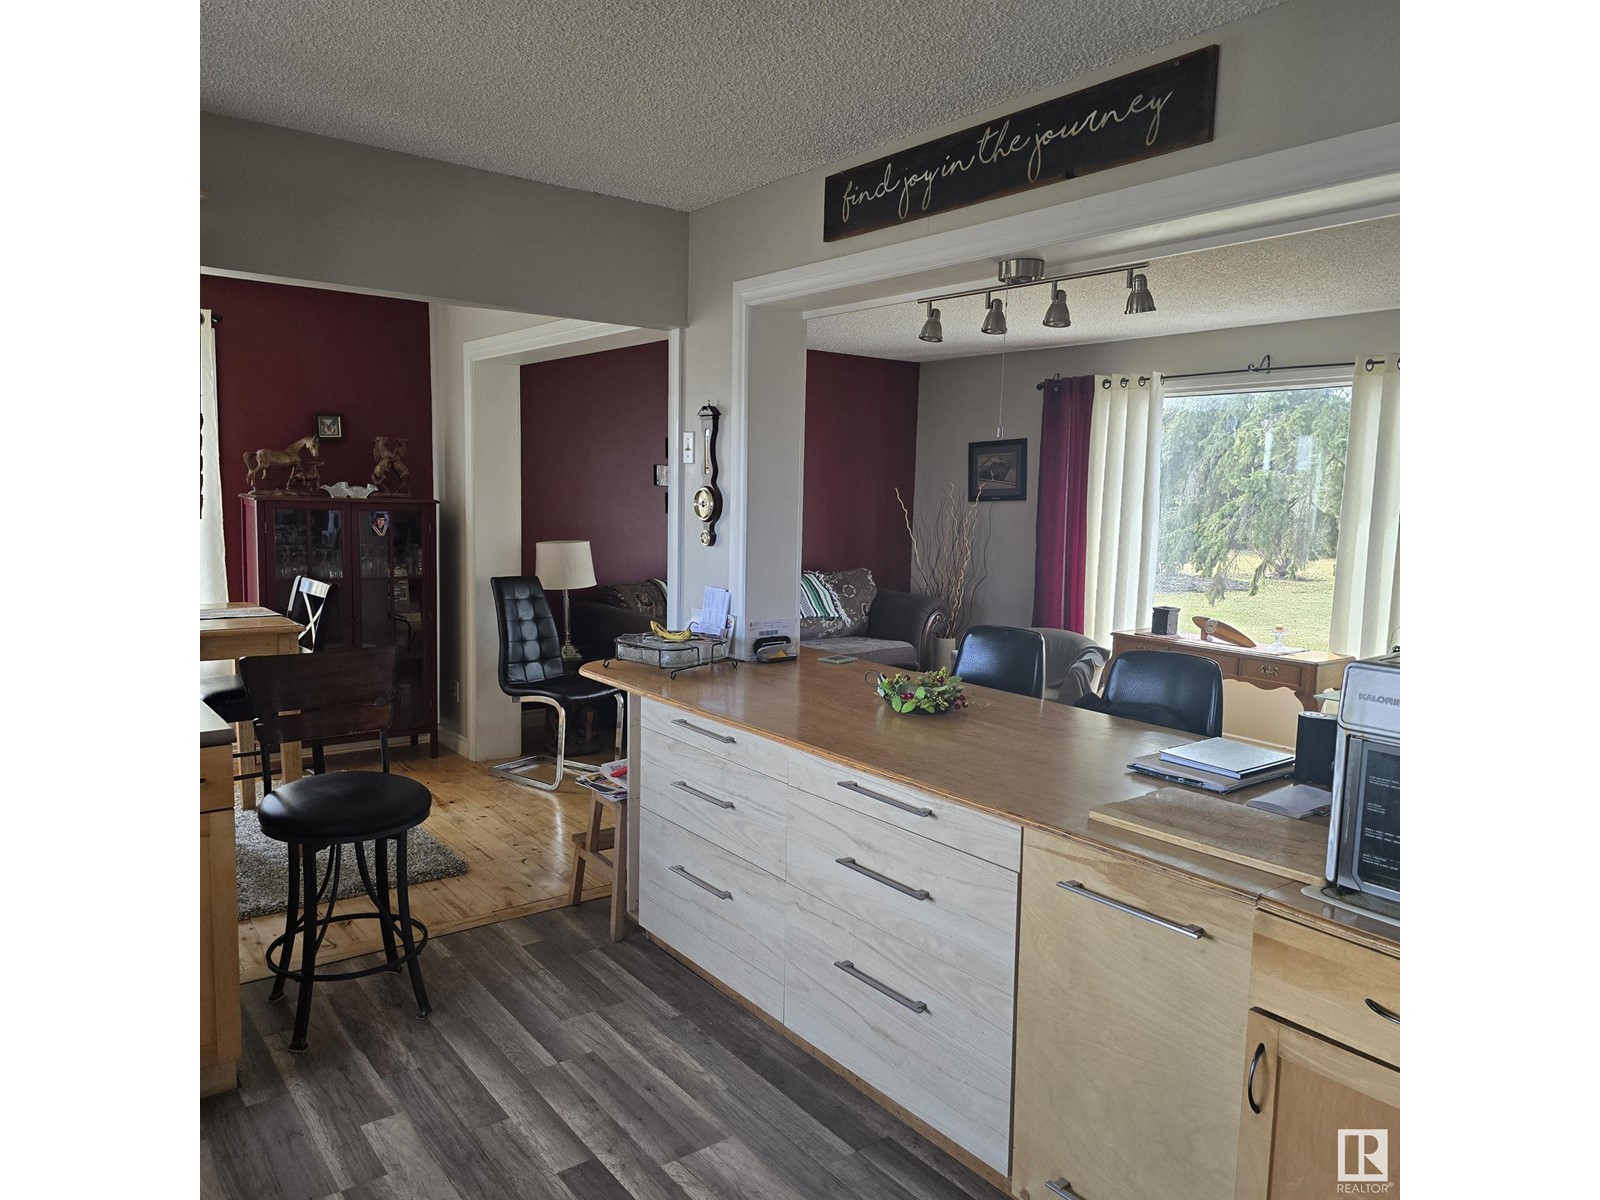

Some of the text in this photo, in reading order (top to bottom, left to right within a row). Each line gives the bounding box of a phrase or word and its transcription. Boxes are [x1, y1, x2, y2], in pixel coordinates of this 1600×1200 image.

[842, 91, 1173, 222] find joy in the journey
